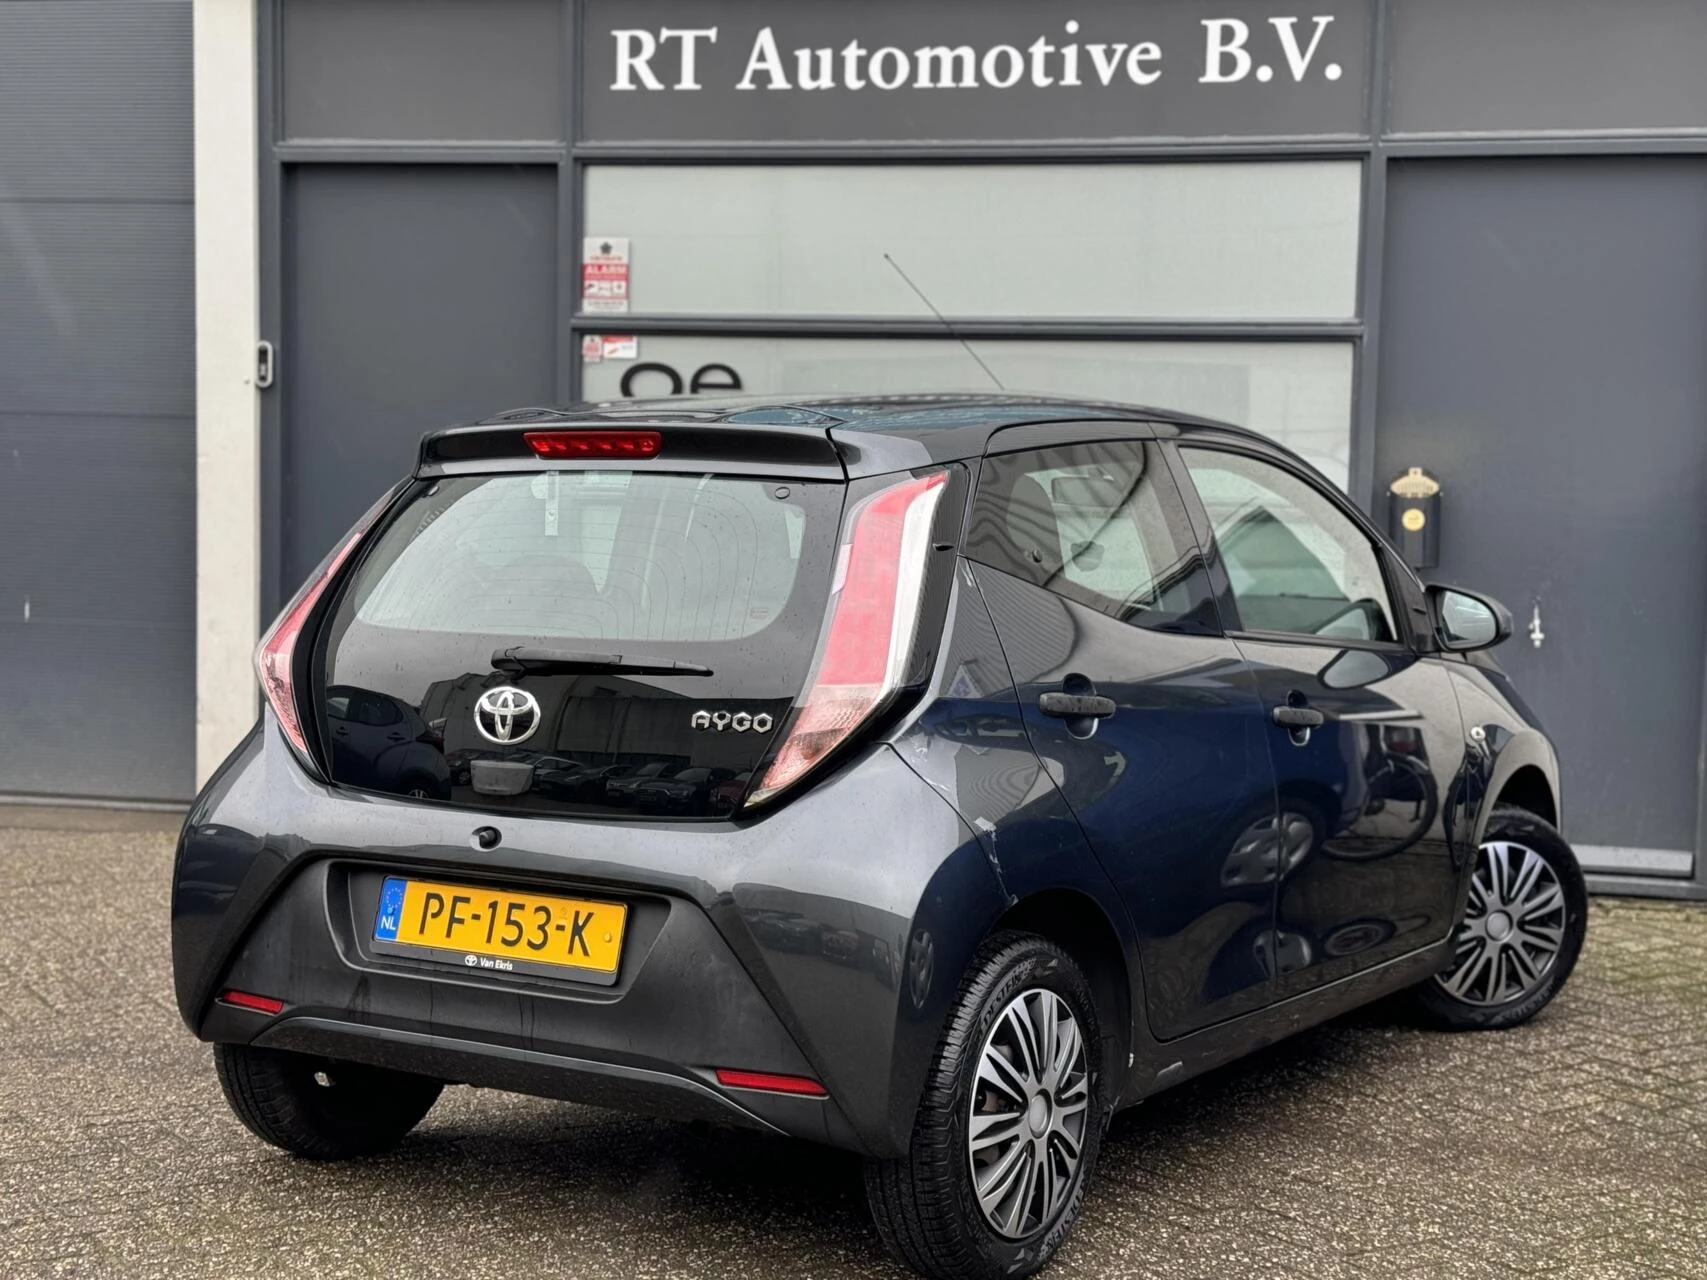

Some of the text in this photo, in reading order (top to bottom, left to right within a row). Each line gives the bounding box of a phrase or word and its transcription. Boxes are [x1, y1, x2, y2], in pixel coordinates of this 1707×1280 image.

[610, 16, 1343, 91] RT Automotive B.V.
[691, 709, 773, 733] AYGO
[380, 915, 397, 931] NL
[418, 891, 595, 958] PF-153-K
[480, 957, 494, 968] Van
